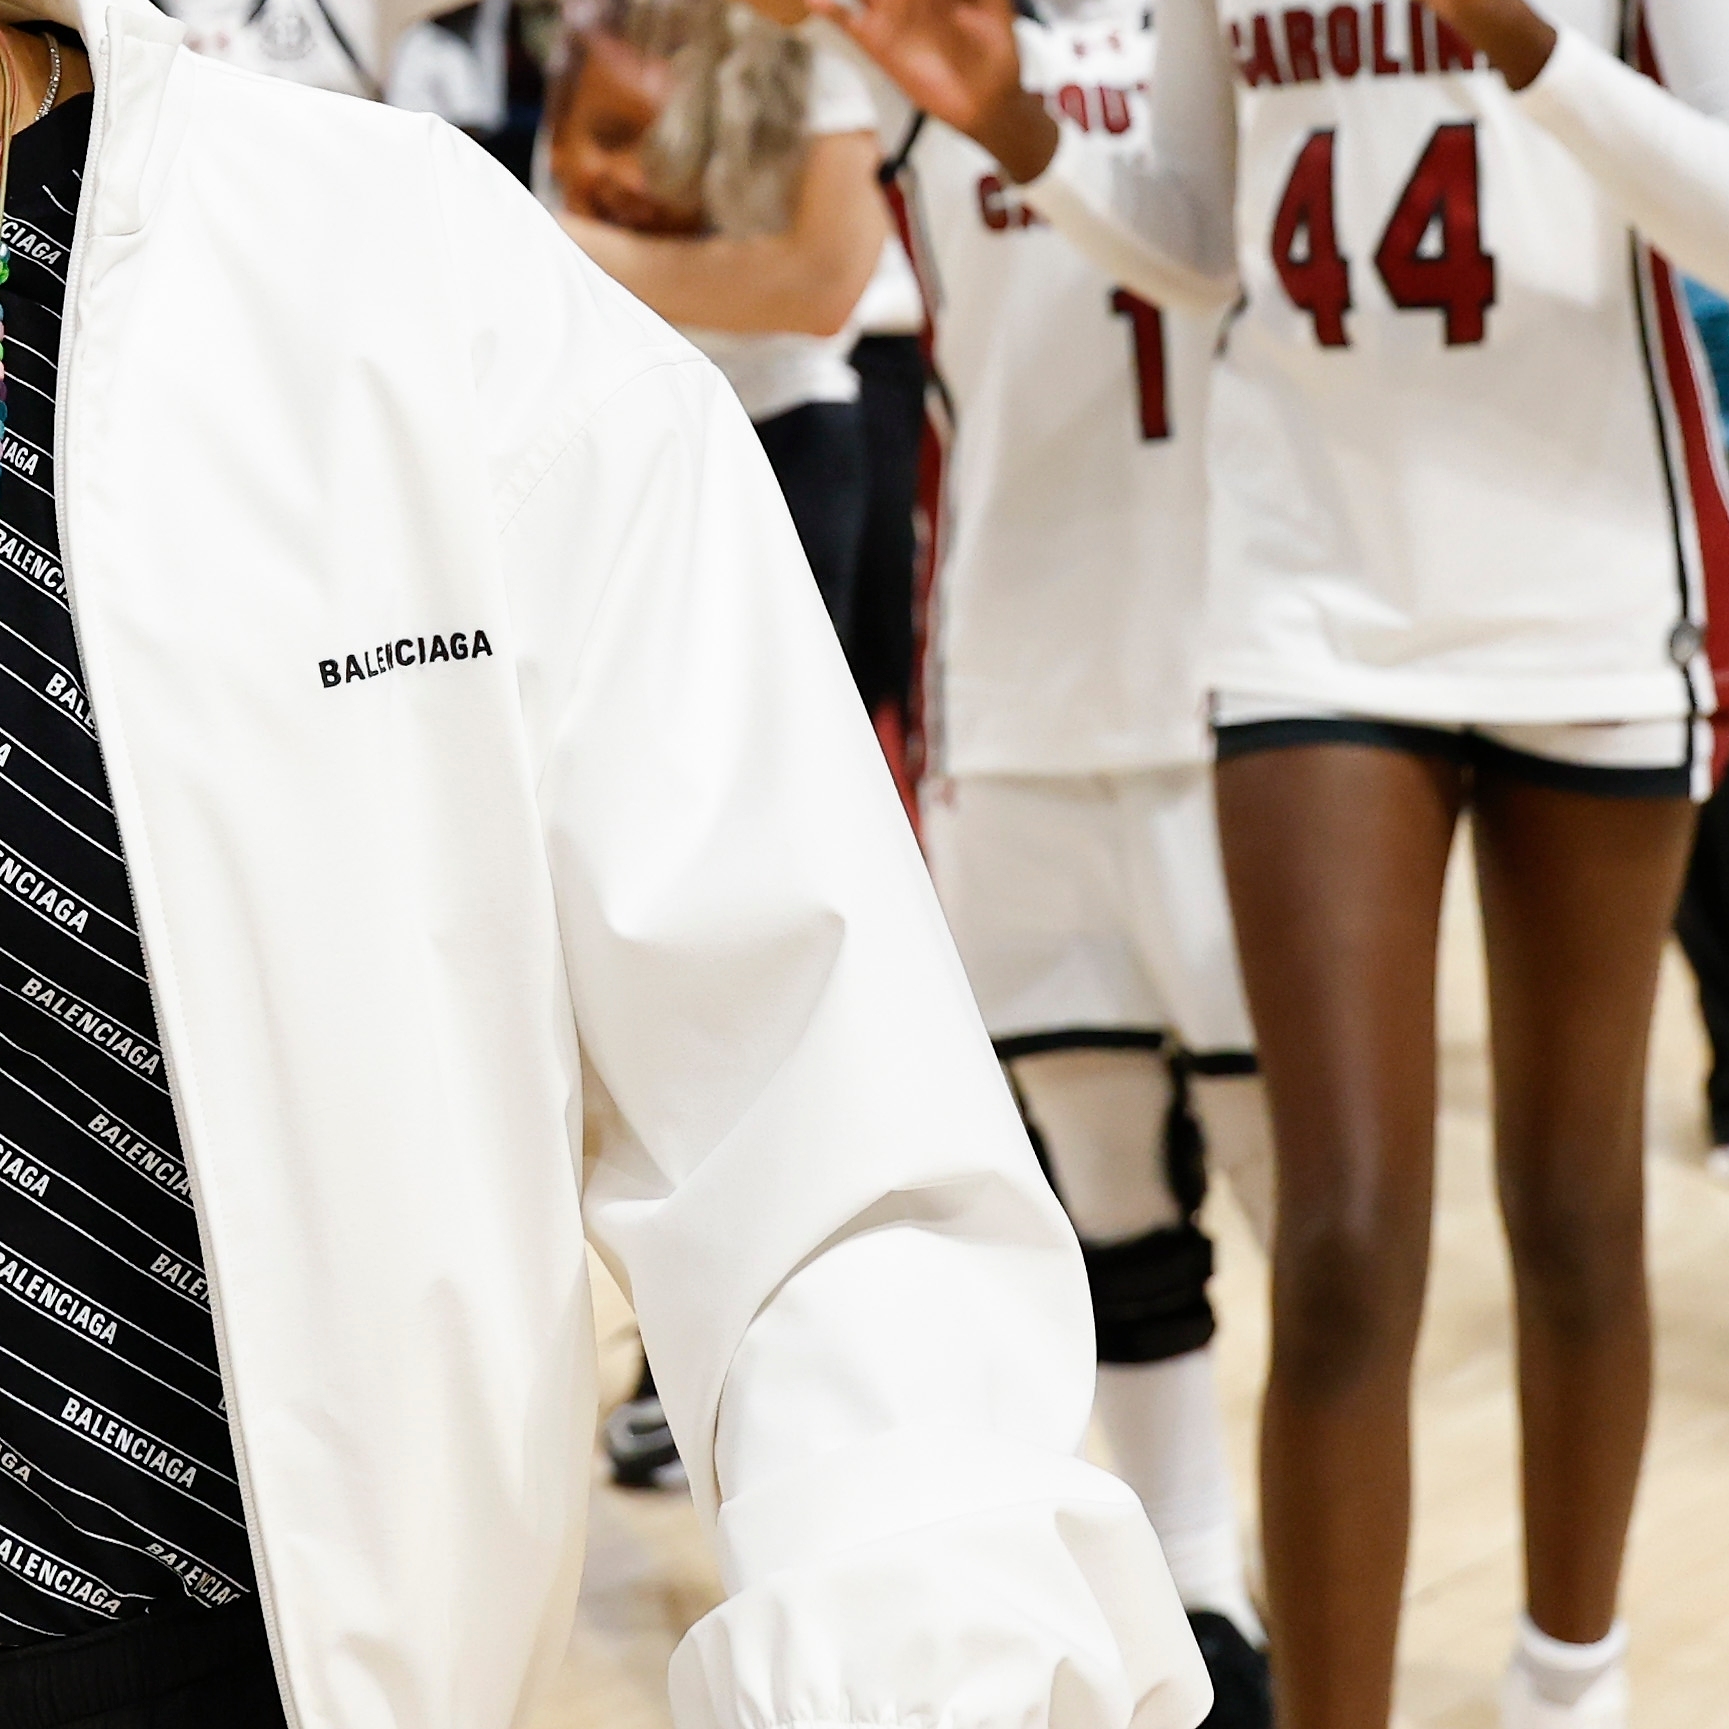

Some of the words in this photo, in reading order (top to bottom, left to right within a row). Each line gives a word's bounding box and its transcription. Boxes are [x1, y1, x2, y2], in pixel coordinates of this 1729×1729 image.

[1272, 120, 1495, 349] 44
[318, 630, 493, 689] BALENCIAGA
[21, 977, 162, 1076] BALENCIAGA
[60, 1396, 198, 1489] BALENCIAGA
